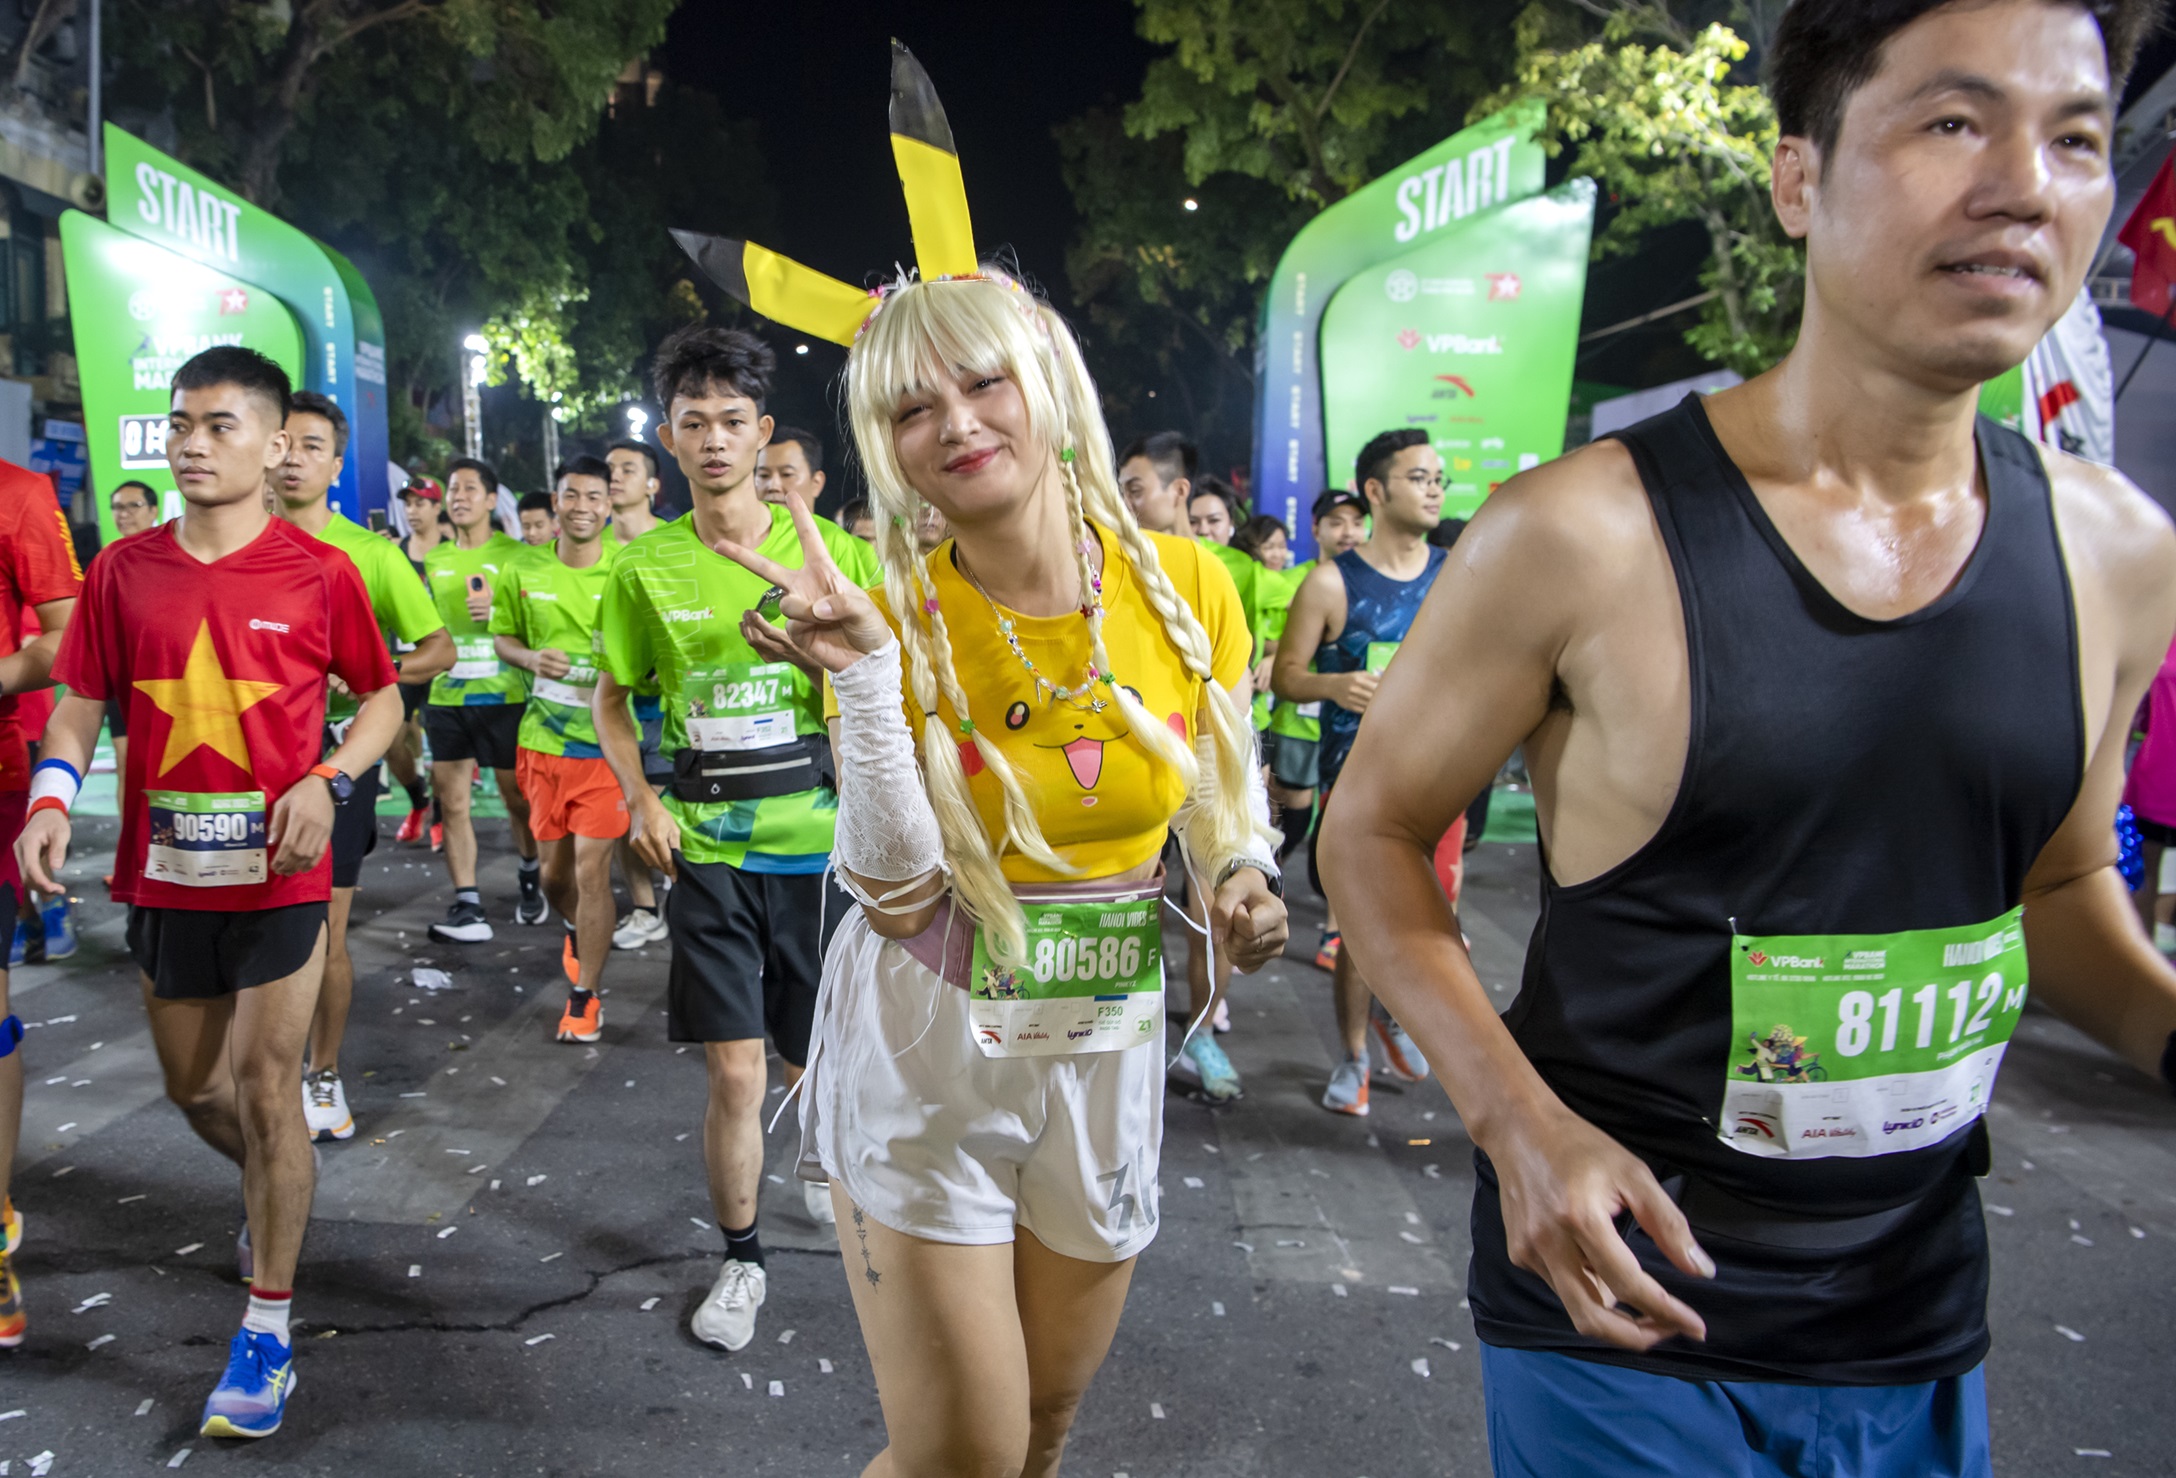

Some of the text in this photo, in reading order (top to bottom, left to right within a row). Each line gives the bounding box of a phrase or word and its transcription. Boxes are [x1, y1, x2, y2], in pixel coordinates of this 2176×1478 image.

[1395, 134, 1516, 242] START
[136, 162, 241, 262] START
[1426, 334, 1503, 354] VPBank
[662, 607, 714, 623] VPBank
[713, 679, 779, 710] 82347
[173, 813, 264, 842] 90590 M
[1034, 935, 1157, 983] 80586 F
[1770, 956, 1824, 968] VPBank
[1098, 1006, 1124, 1017] F350
[1835, 971, 2004, 1057] 81112
[2002, 983, 2027, 1014] M
[1138, 1019, 1152, 1032] 21
[1801, 1128, 1827, 1138] AIA
